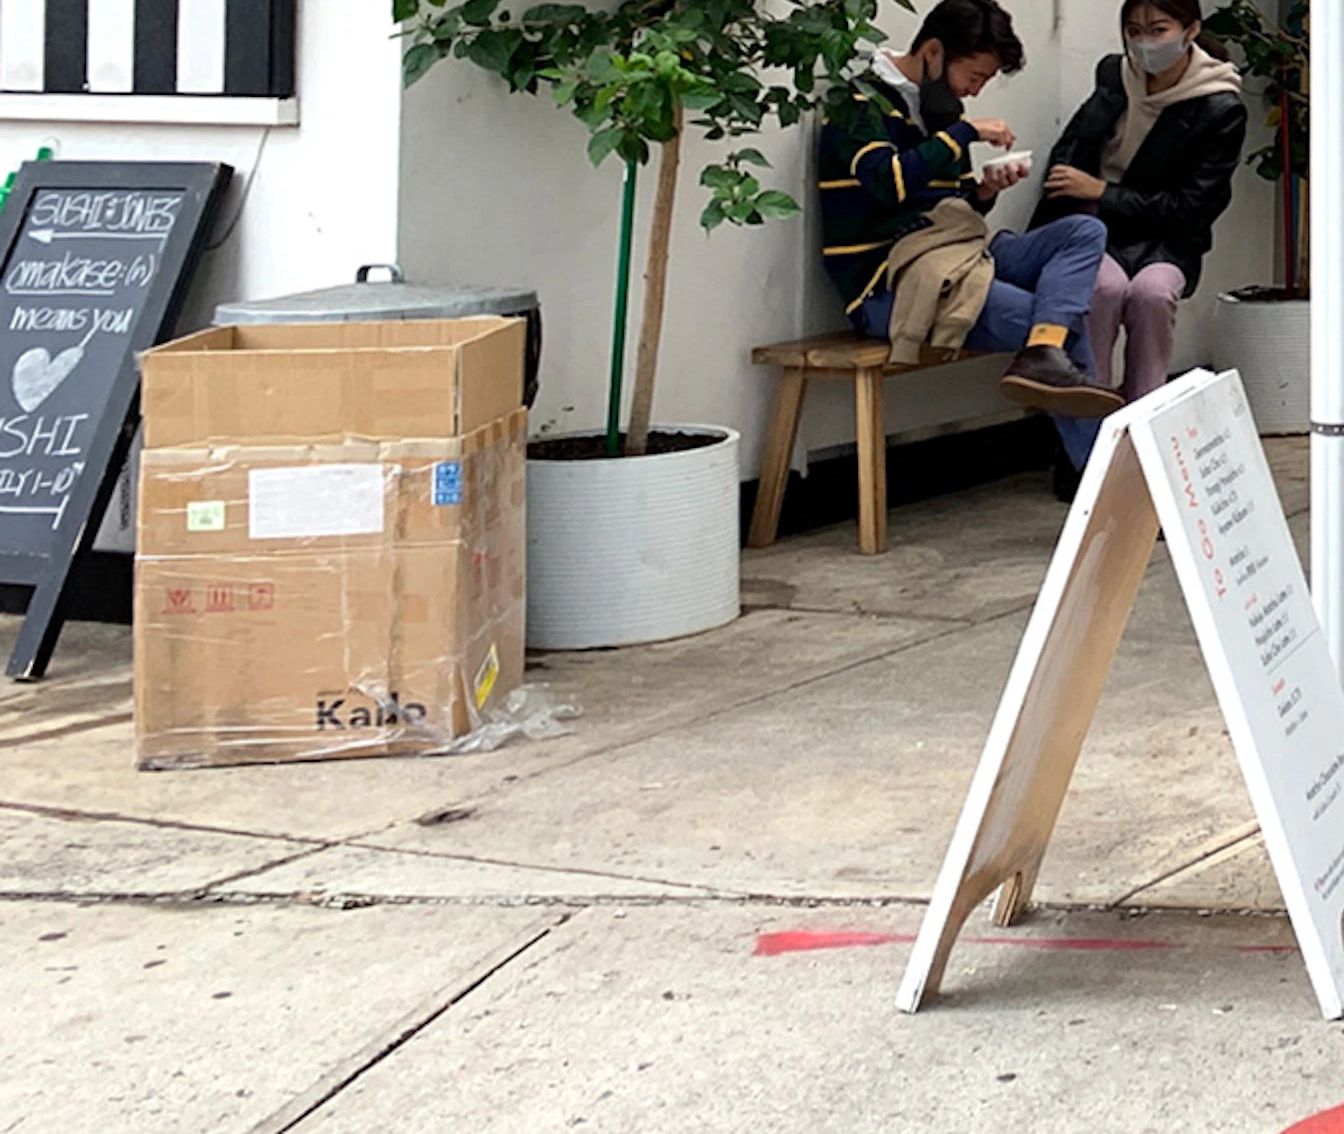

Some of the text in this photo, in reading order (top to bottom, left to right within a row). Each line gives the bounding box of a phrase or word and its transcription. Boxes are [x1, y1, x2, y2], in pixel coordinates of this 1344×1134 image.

[9, 306, 134, 340] means you
[0, 413, 89, 458] SHI
